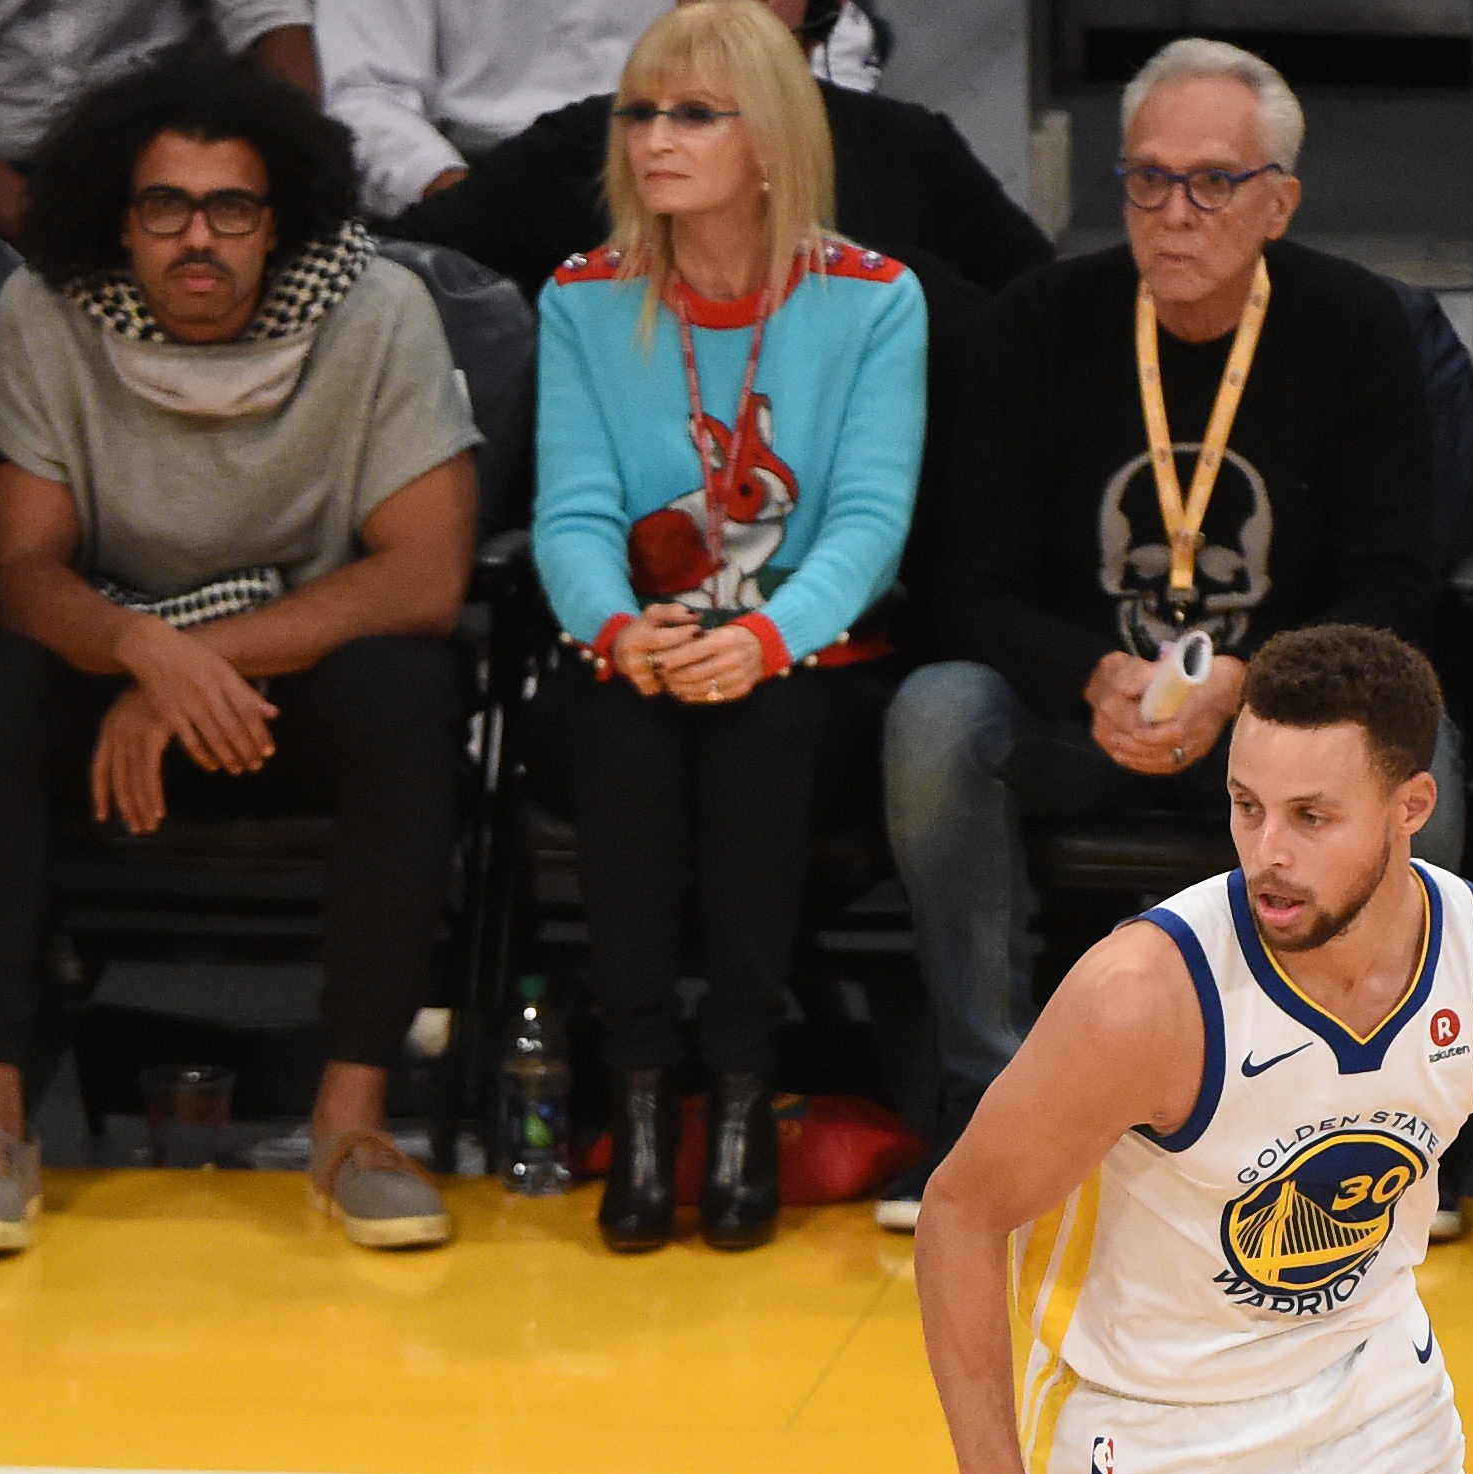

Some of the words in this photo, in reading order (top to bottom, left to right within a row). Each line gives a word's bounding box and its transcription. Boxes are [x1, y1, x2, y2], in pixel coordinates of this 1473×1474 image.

[1237, 1113, 1361, 1186] GOLDEN
[1369, 1110, 1440, 1155] STATE
[1330, 1165, 1411, 1212] 30
